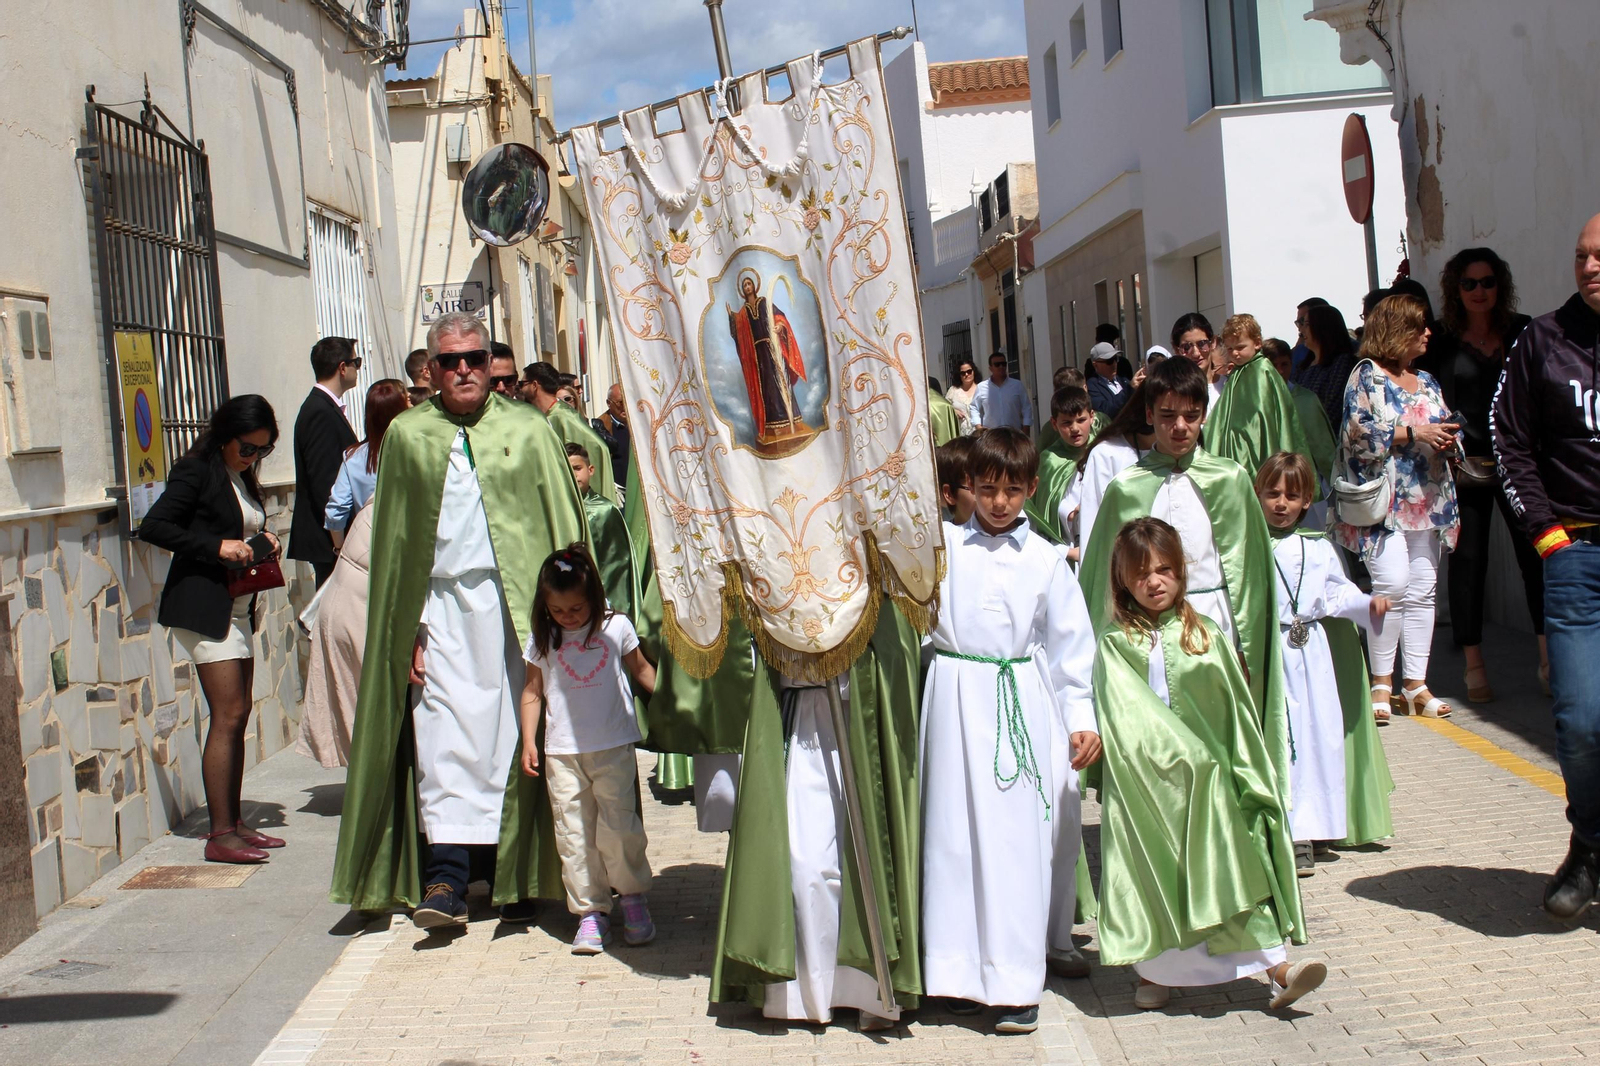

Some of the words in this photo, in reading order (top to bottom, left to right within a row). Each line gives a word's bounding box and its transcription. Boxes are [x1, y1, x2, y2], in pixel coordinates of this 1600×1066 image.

[441, 289, 464, 299] CALLE
[431, 299, 476, 314] AIRE
[122, 359, 152, 373] SEÑALIZACIÓN
[124, 374, 153, 386] EXCEPCIONAL
